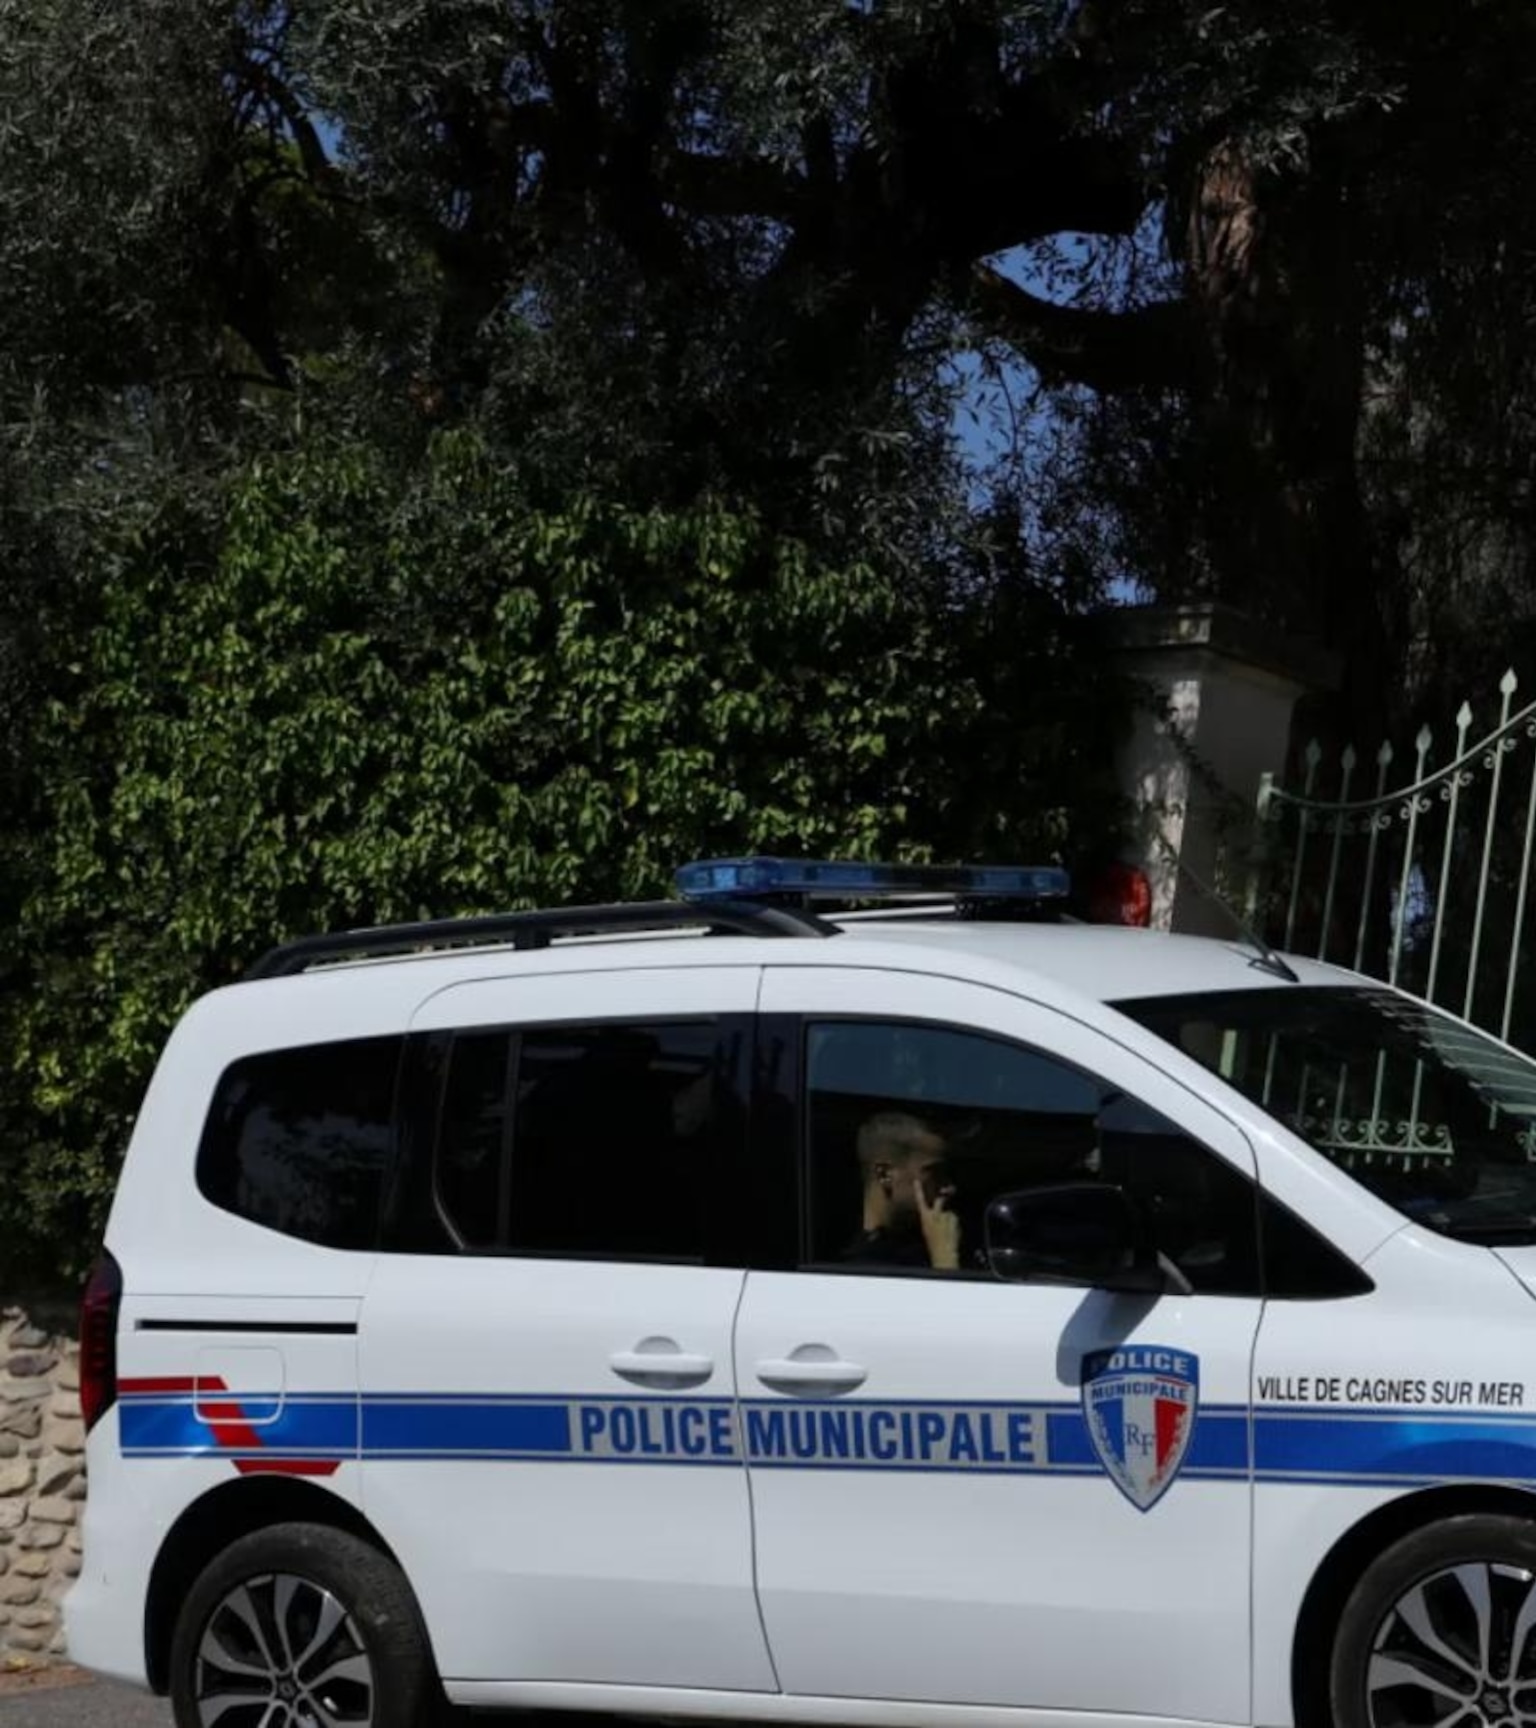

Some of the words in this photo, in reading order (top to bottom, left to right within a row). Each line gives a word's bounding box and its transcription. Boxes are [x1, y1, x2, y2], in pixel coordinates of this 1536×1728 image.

[1090, 1381, 1188, 1401] MUNICIPALE
[1257, 1377, 1308, 1401] VILLE
[1315, 1378, 1341, 1402] DE
[1346, 1379, 1426, 1404] CAGNES
[1431, 1381, 1472, 1405] SUR
[1478, 1382, 1525, 1406] MER
[579, 1406, 734, 1458] POLICE
[748, 1409, 1036, 1464] MUNICIPALE
